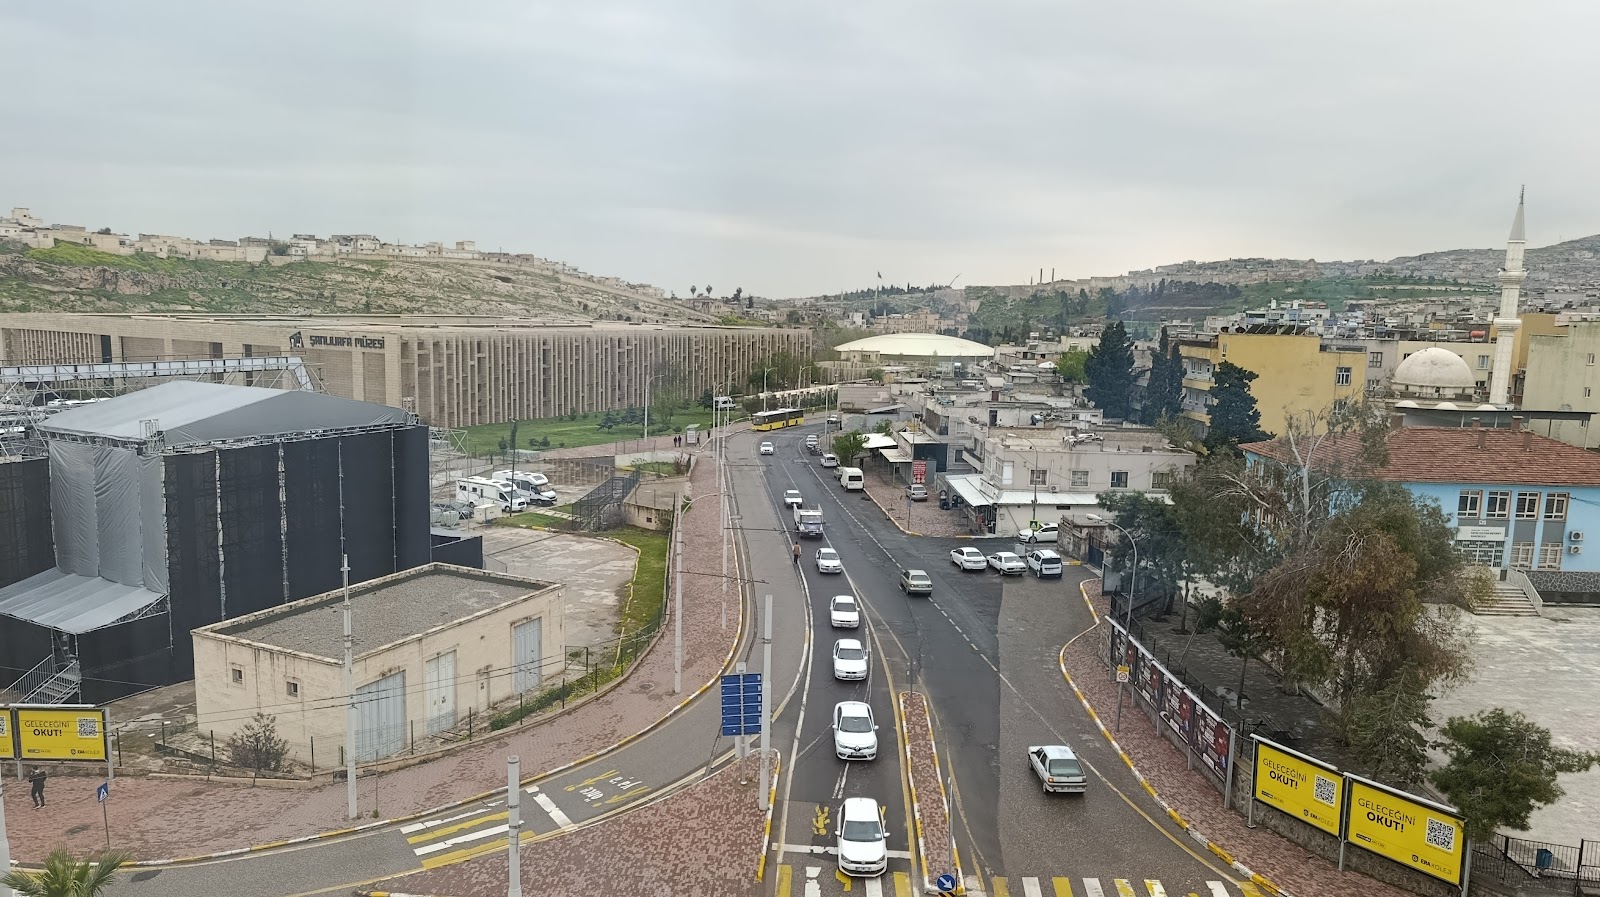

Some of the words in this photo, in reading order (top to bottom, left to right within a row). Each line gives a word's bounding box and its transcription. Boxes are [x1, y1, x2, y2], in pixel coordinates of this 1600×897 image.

[355, 335, 385, 349] MÜZESİ
[33, 729, 62, 737] OKUT!
[1262, 758, 1307, 783] GELECEĞİNİ
[1269, 770, 1298, 790] OKUT!
[1358, 798, 1416, 826] GELECEĞİNİ
[1366, 811, 1404, 833] OKUT!
